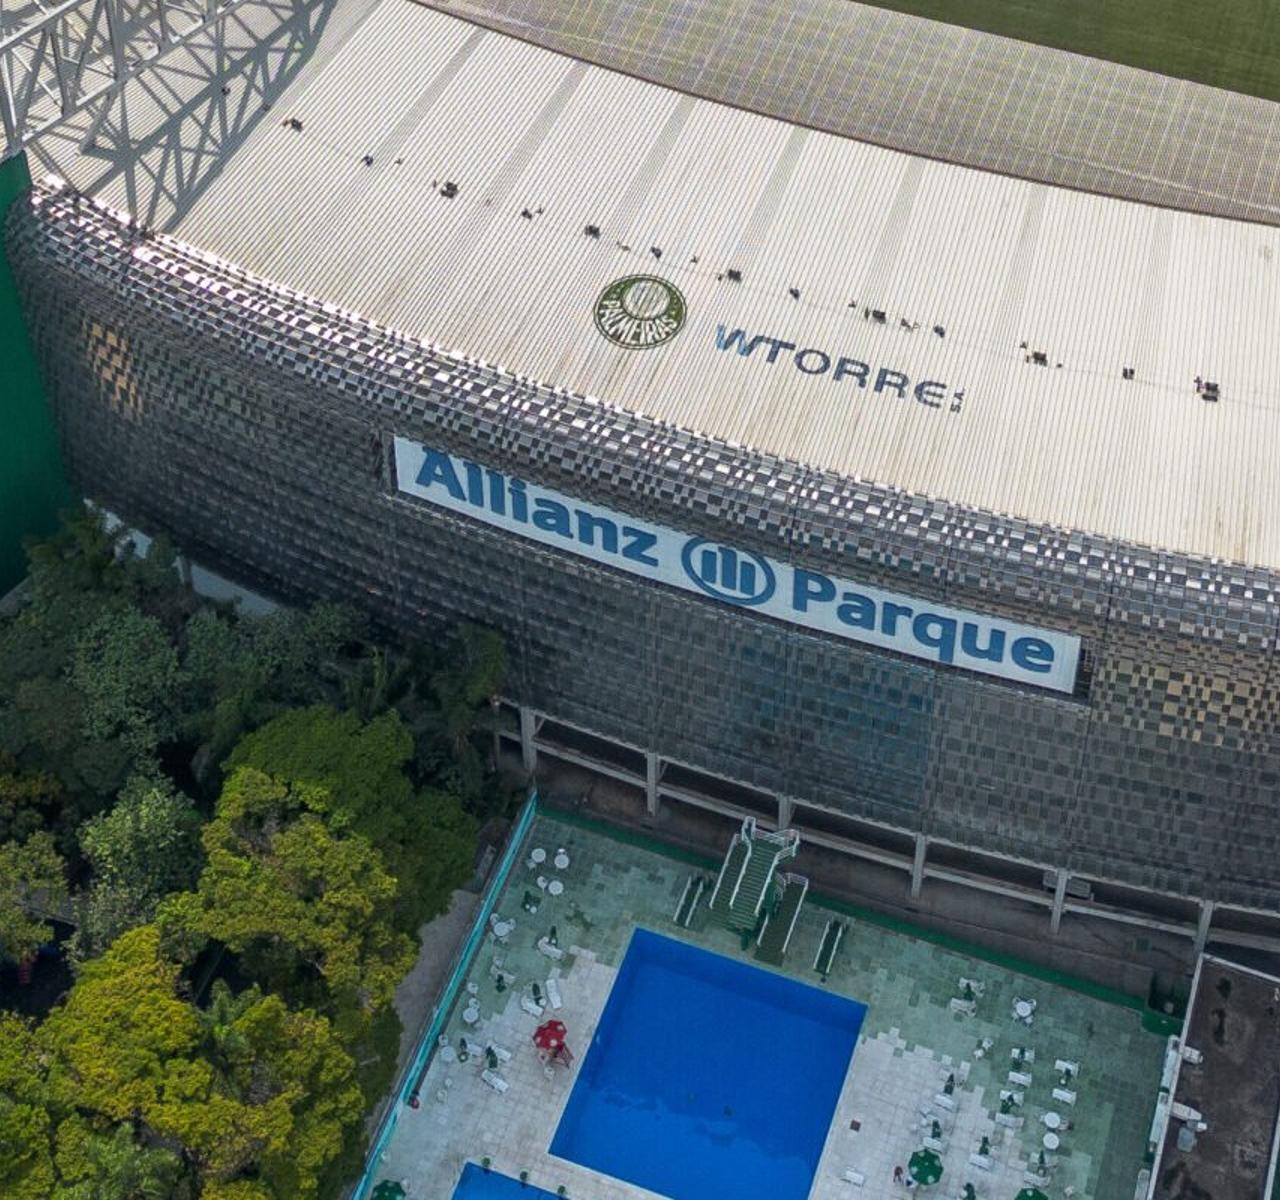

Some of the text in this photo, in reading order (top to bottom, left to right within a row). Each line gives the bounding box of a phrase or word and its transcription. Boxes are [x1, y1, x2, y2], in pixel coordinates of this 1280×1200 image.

[599, 300, 677, 345] PALMEIRAS
[715, 323, 948, 410] WTORRE
[414, 446, 1055, 675] Allianz Parque
